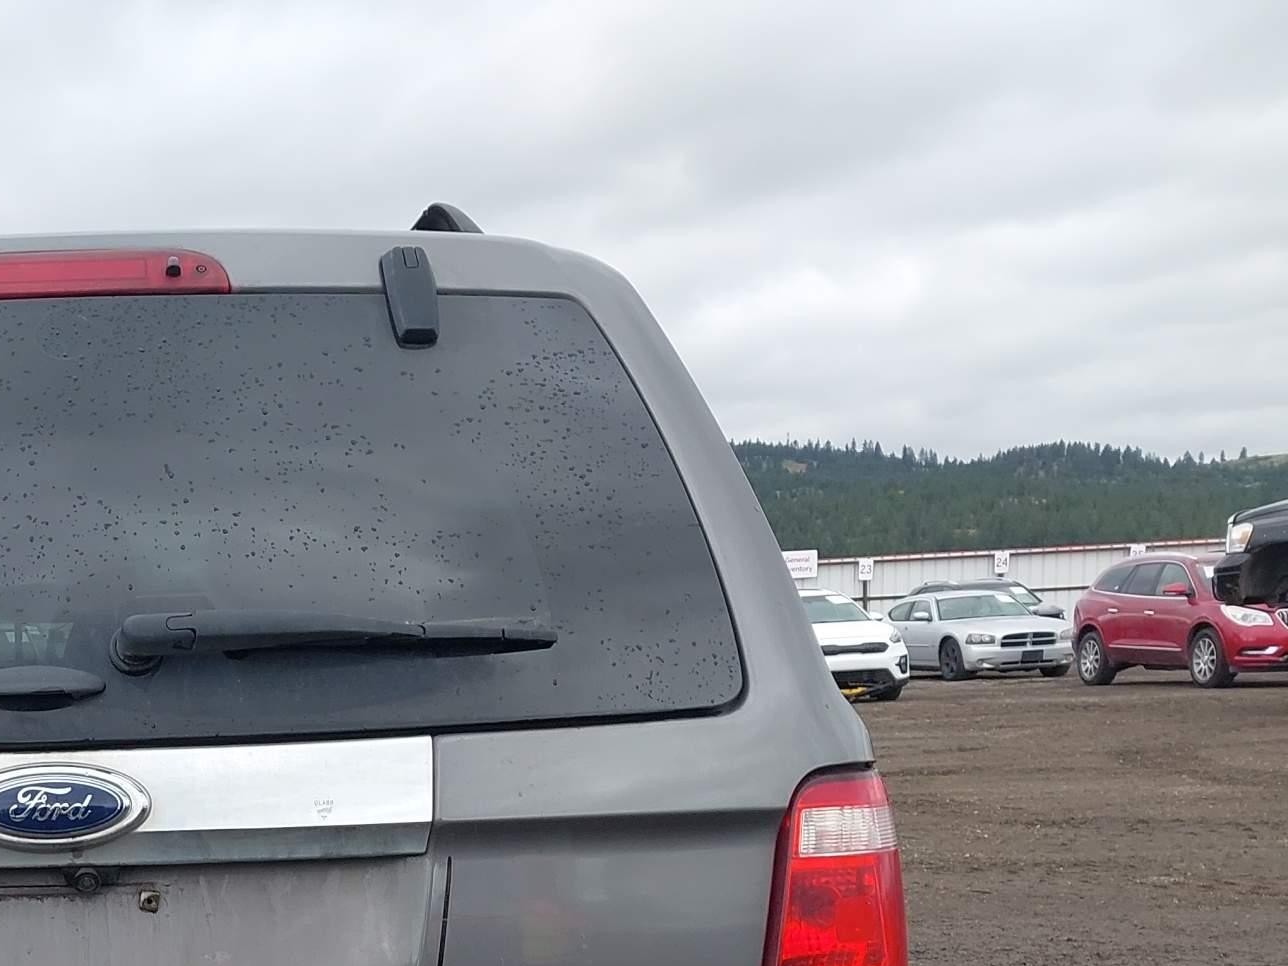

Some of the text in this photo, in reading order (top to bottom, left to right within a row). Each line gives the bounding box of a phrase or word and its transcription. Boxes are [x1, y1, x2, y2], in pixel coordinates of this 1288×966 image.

[996, 557, 1008, 568] 24
[860, 564, 872, 574] 23
[9, 786, 93, 822] Ford
